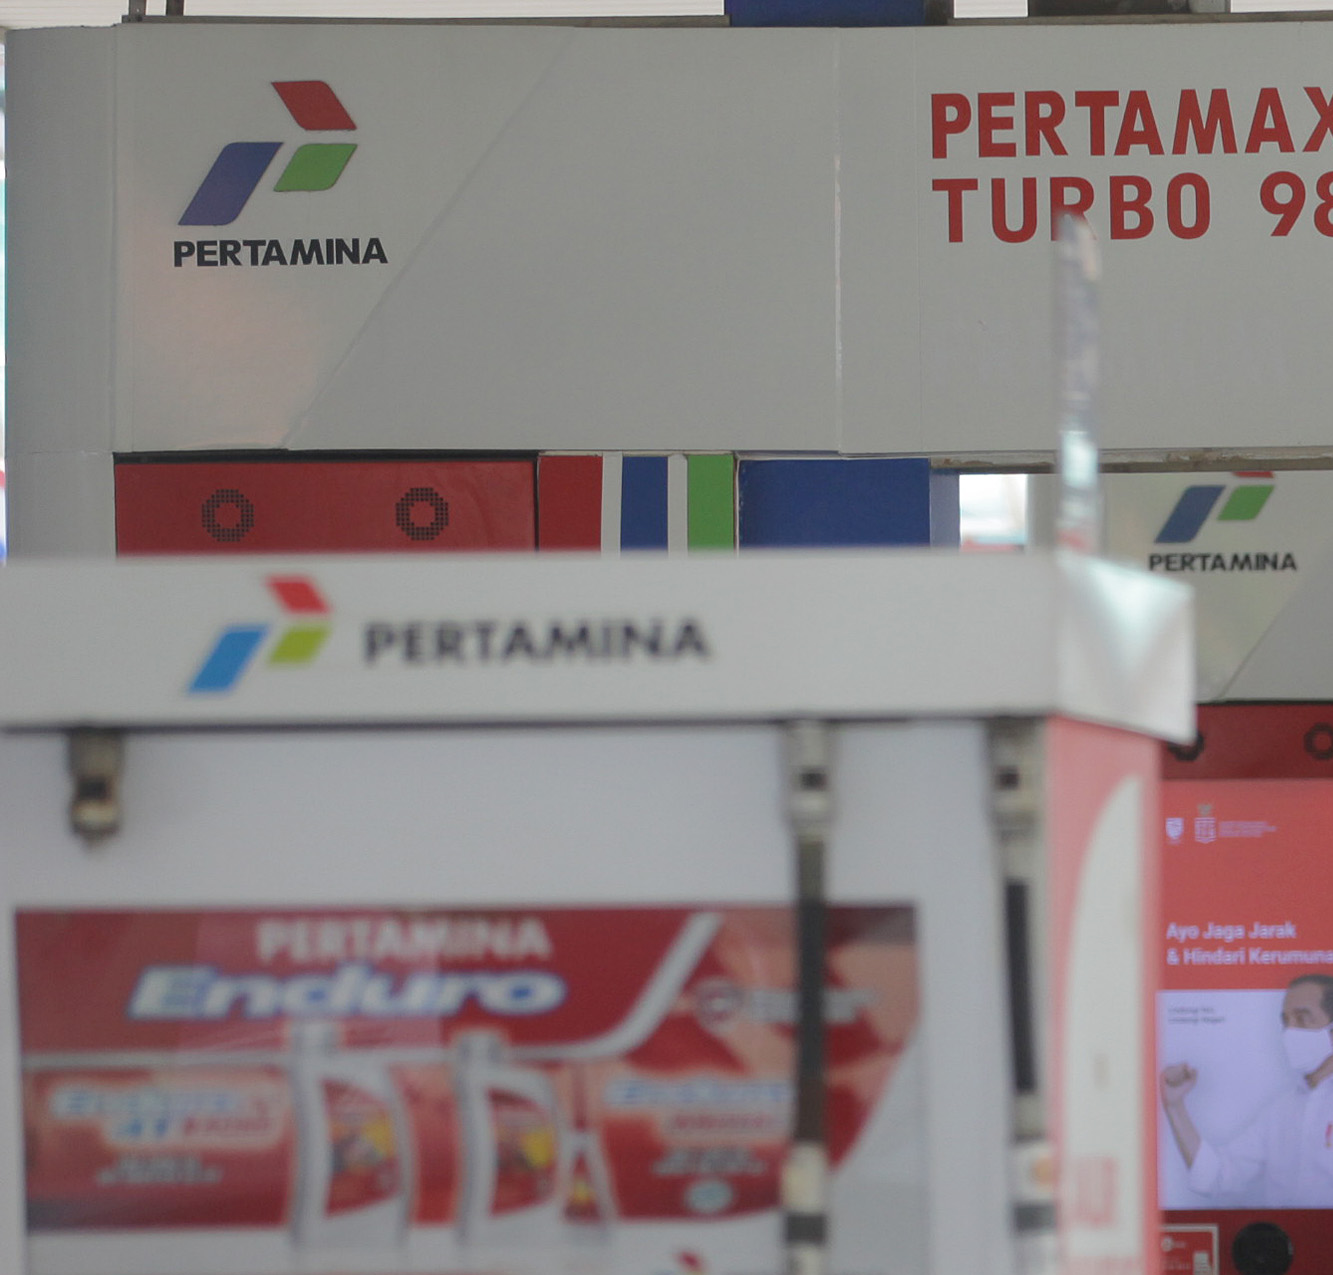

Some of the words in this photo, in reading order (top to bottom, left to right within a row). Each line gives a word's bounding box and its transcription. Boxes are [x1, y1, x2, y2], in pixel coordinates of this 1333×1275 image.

[932, 172, 1211, 244] TURBO
[173, 237, 389, 268] PERTAMINA
[1149, 552, 1297, 572] PERTAMINA
[363, 617, 713, 667] PERTAMINA
[257, 918, 550, 961] PERTAMINA
[1166, 923, 1199, 942] Ayo
[1203, 922, 1244, 942] Jaga
[1249, 921, 1297, 939] Jarak
[1184, 948, 1245, 964] Hindari
[126, 962, 568, 1022] Enduro
